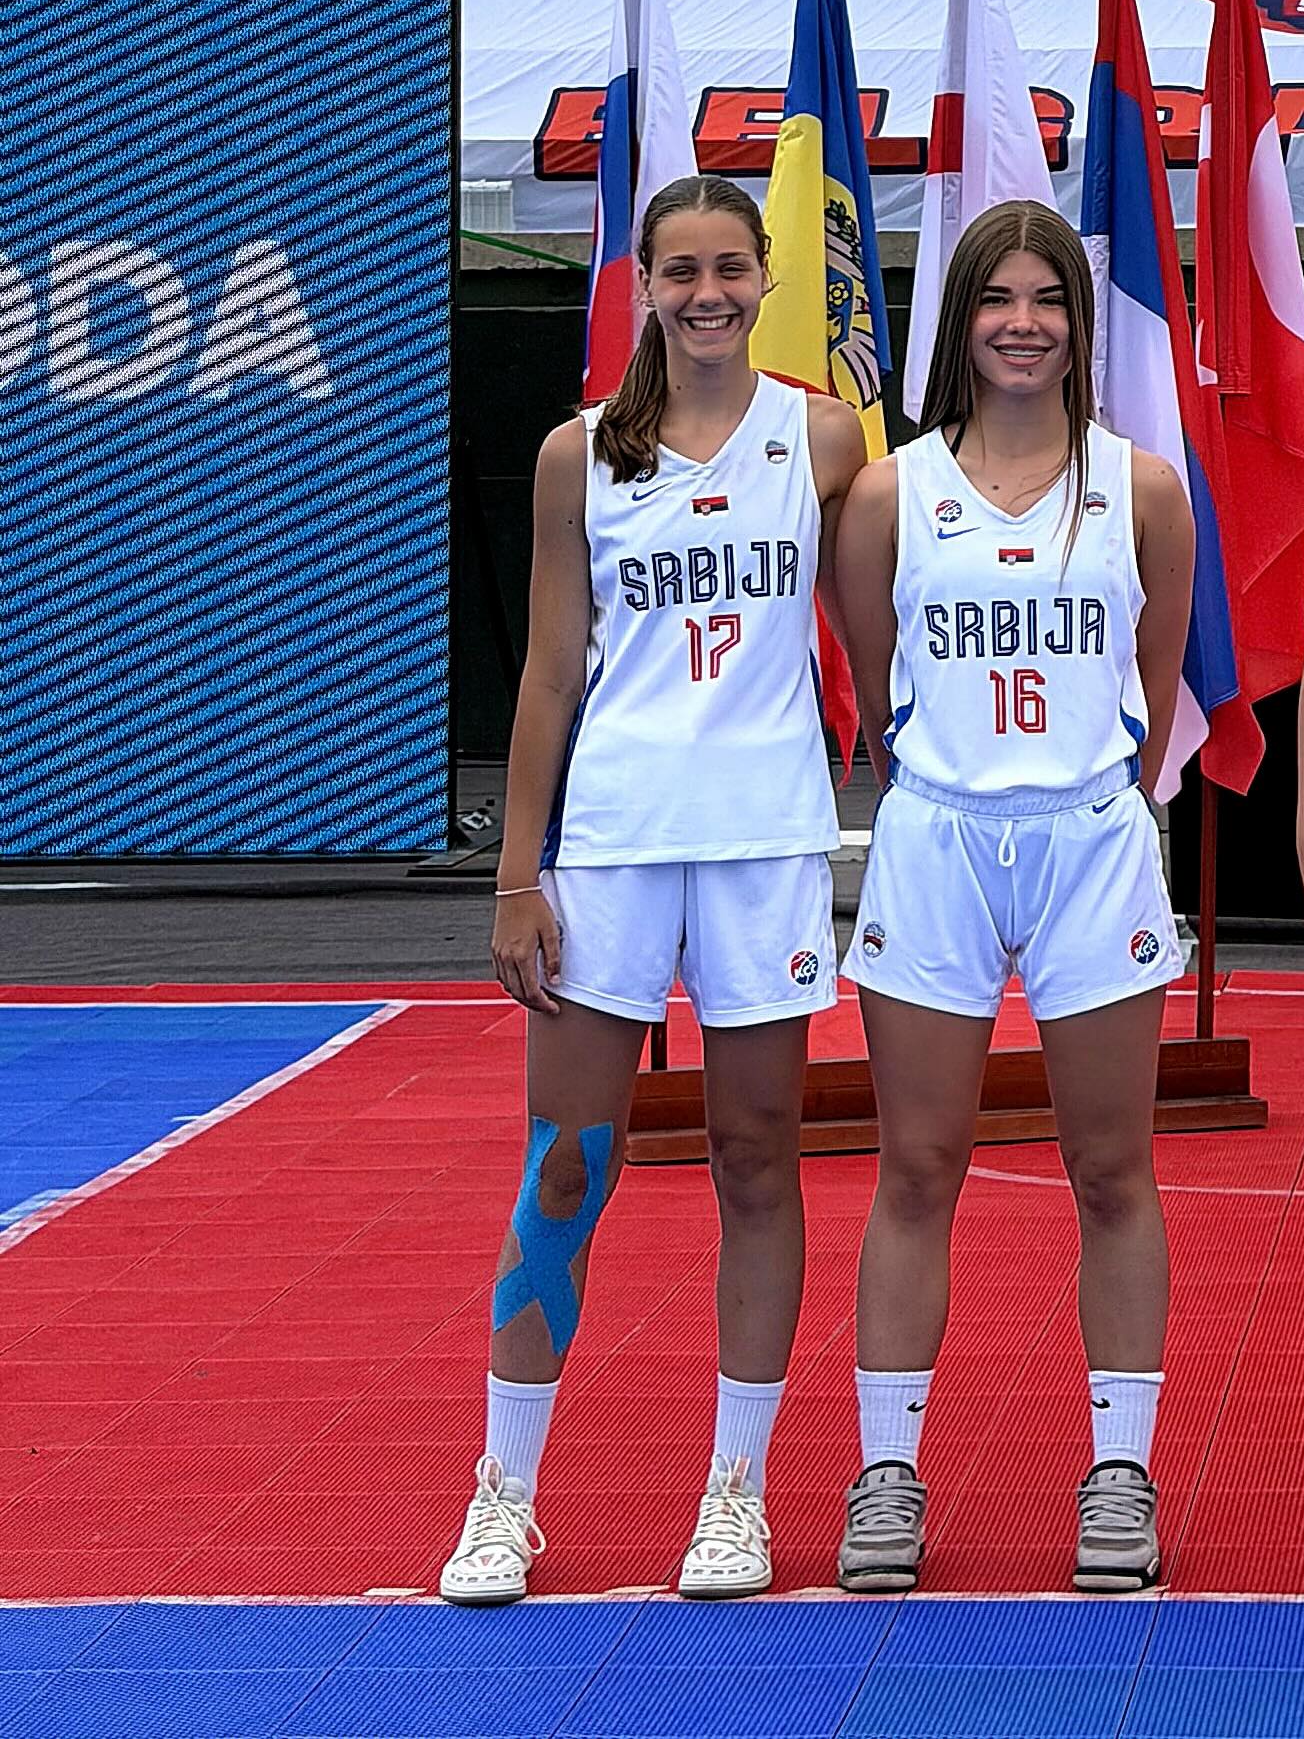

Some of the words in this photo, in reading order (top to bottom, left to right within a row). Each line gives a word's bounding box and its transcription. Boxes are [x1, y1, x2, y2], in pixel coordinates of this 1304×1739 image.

[619, 540, 799, 612] SRBIJA
[685, 613, 741, 682] 17
[924, 598, 1105, 660] SRBIJA
[989, 669, 1047, 734] 16
